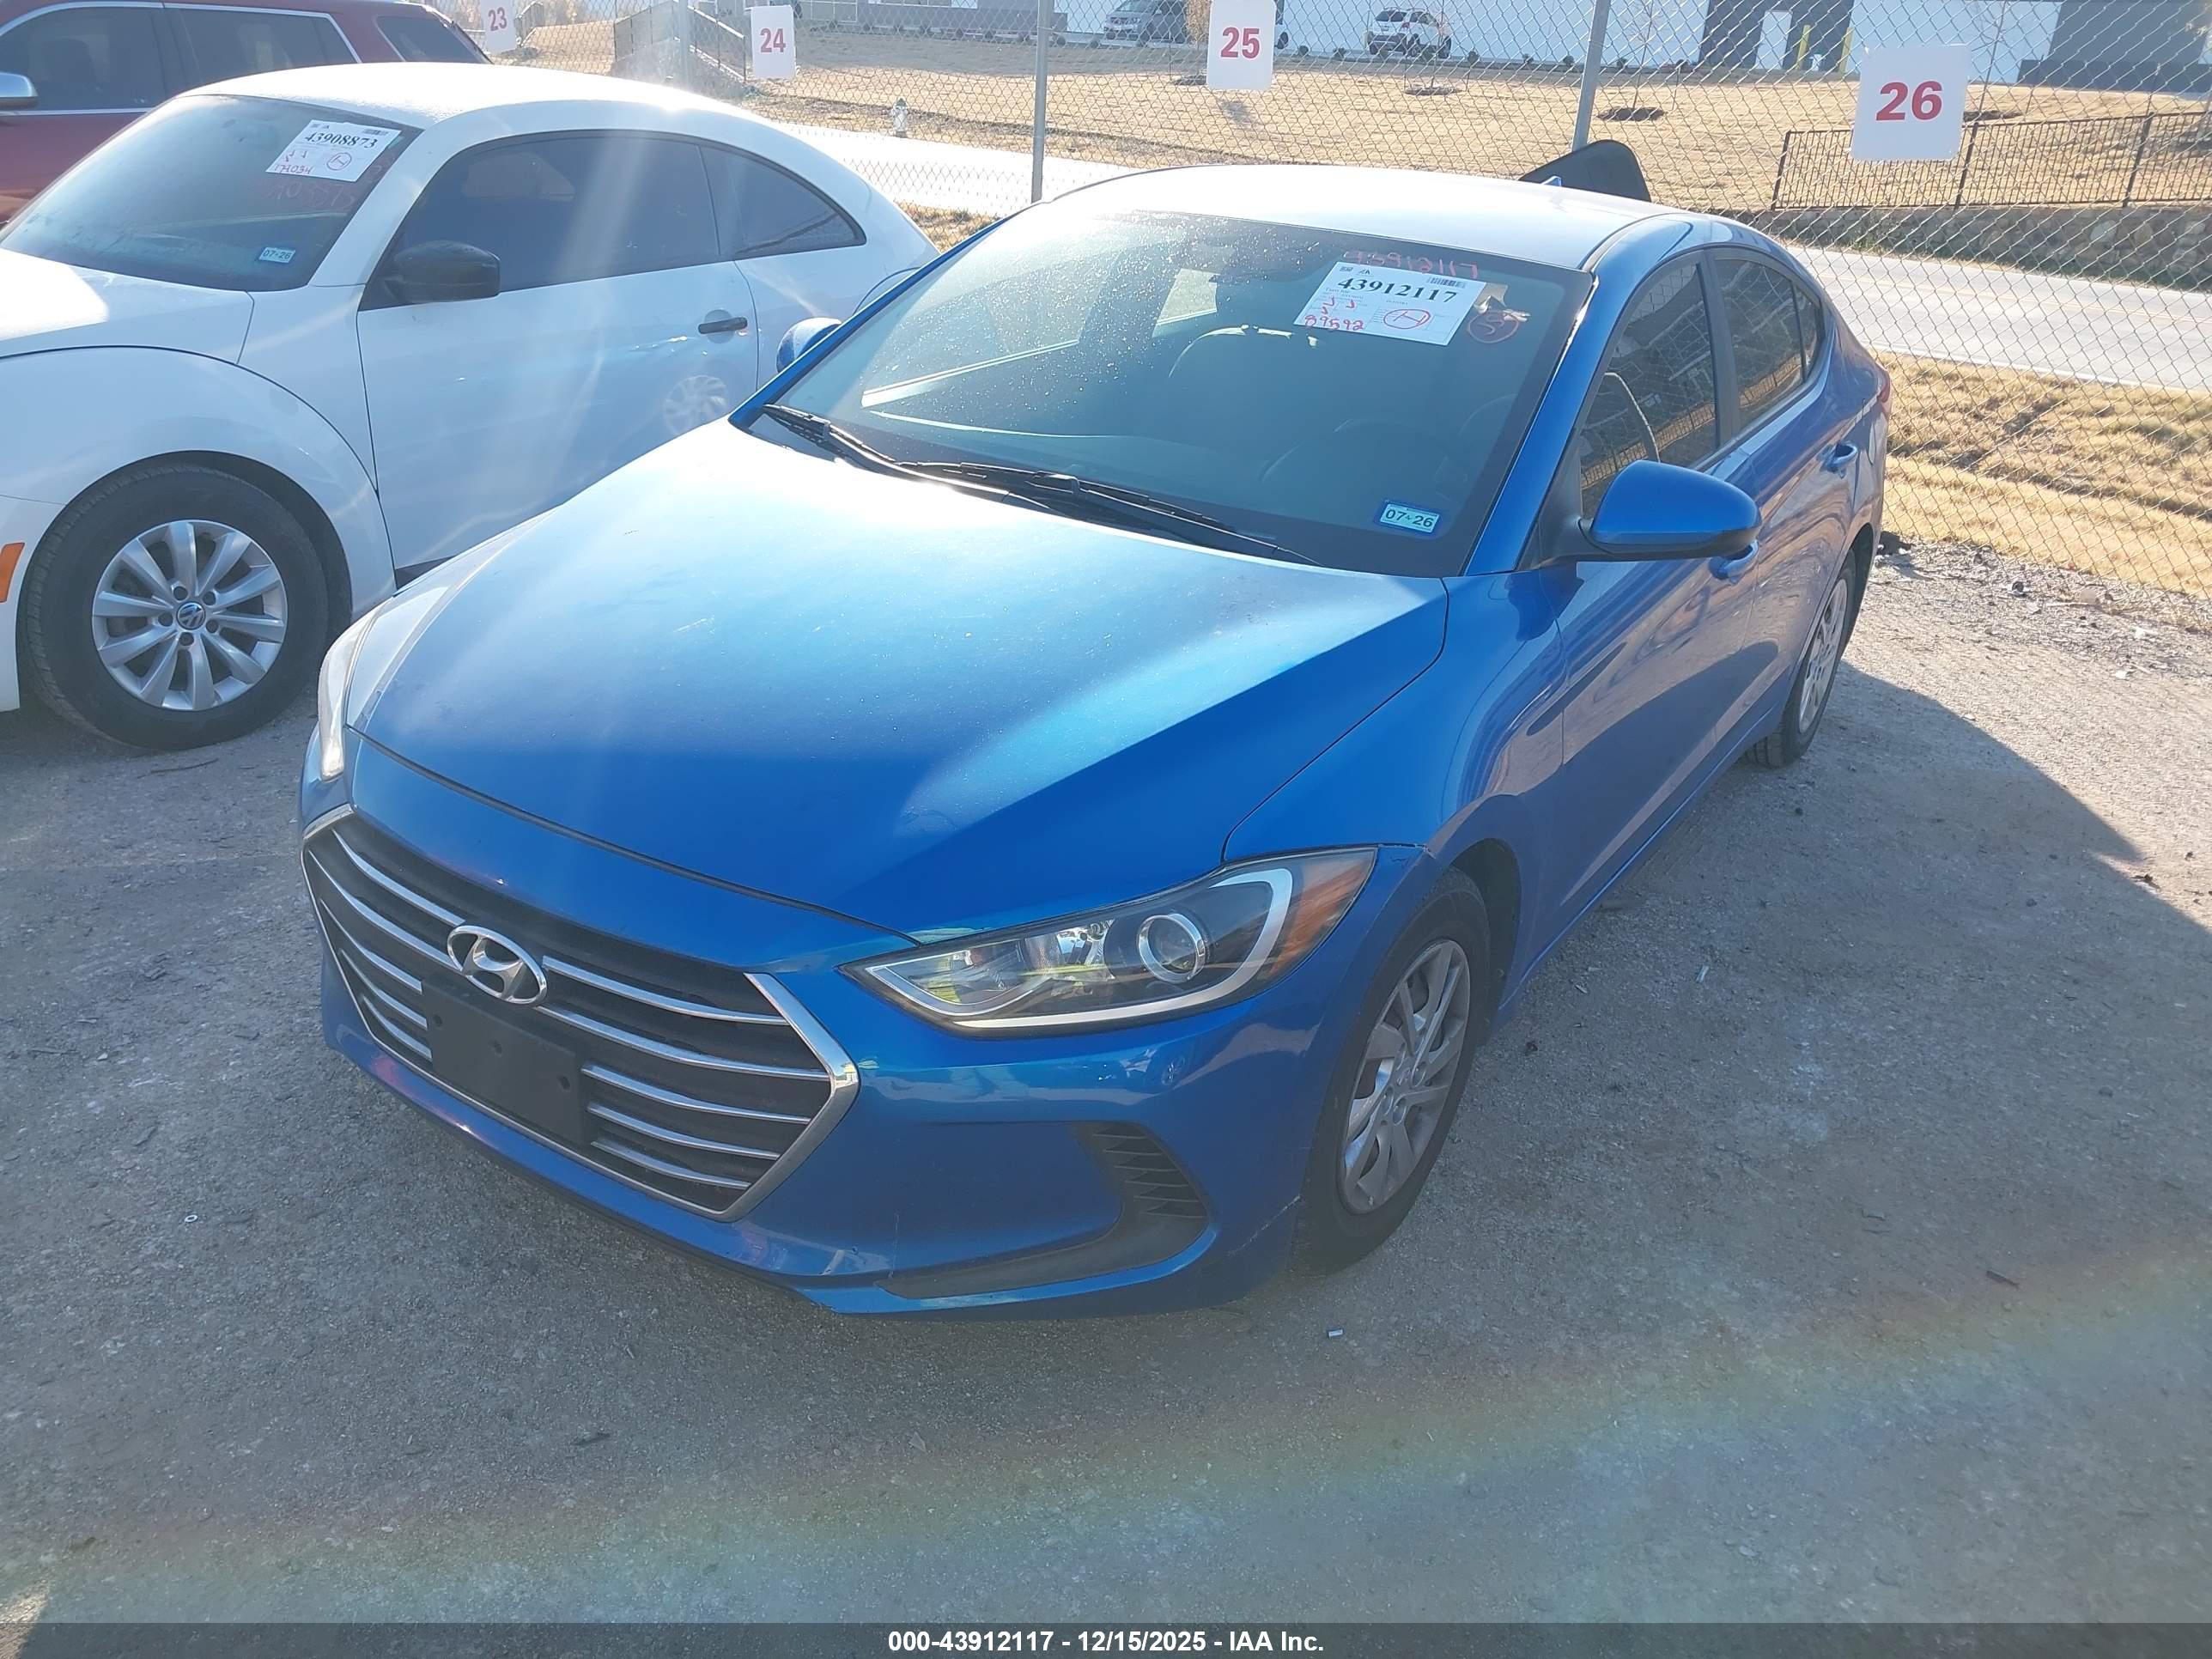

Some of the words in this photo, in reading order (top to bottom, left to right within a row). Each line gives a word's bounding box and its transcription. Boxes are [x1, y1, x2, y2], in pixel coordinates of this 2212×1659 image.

[488, 7, 507, 31] 23
[760, 27, 787, 52] 24
[1221, 27, 1260, 58] 25
[1875, 81, 1942, 120] 26
[305, 131, 378, 149] 43908873
[1337, 277, 1457, 303] 43912117
